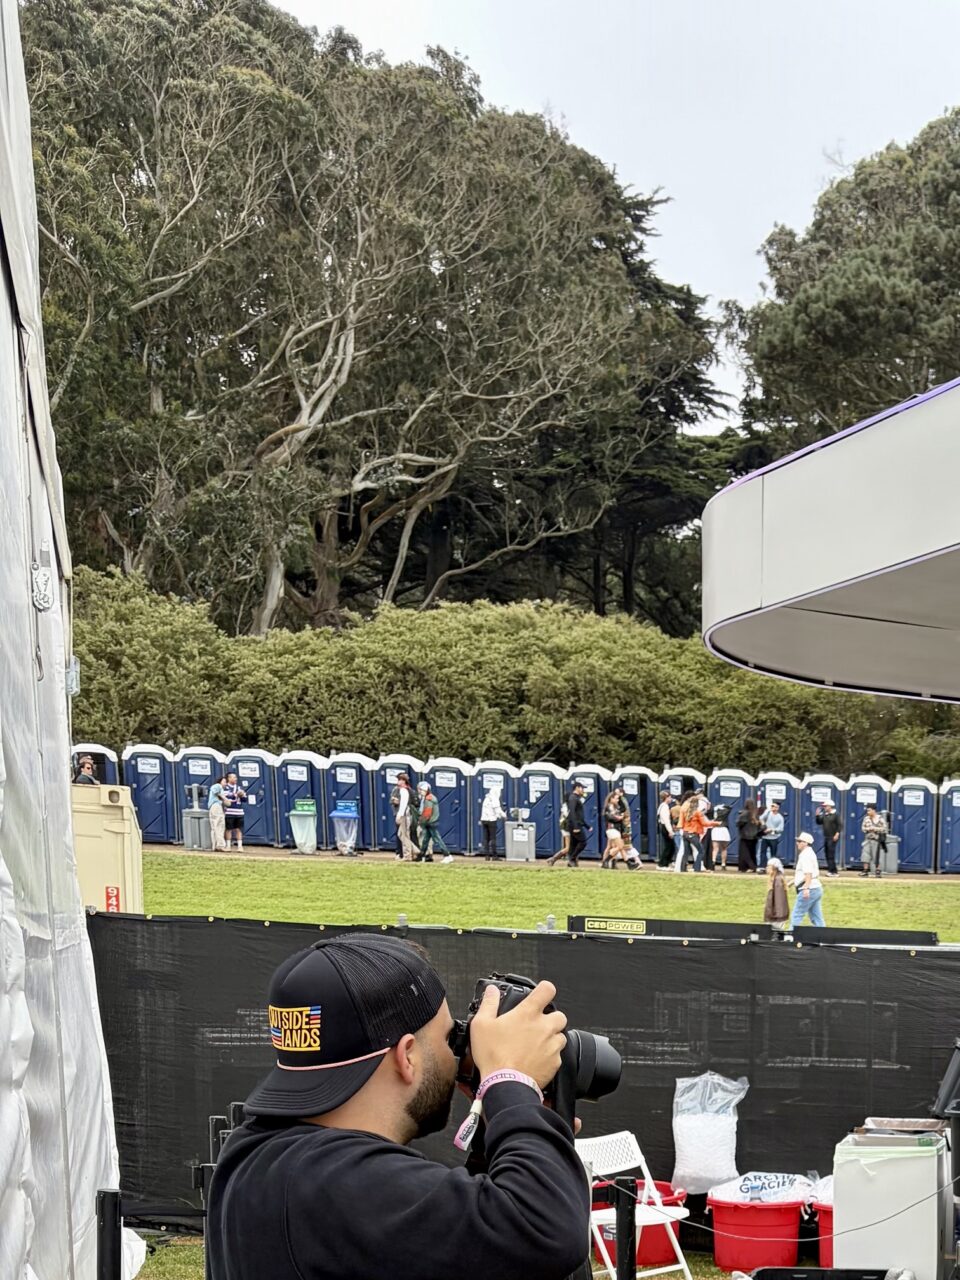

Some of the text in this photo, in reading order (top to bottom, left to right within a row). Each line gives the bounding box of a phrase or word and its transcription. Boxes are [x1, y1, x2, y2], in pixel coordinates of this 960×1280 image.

[608, 922, 642, 931] POWER
[269, 1005, 310, 1029] OUTSIDE
[281, 1027, 321, 1048] LANDS
